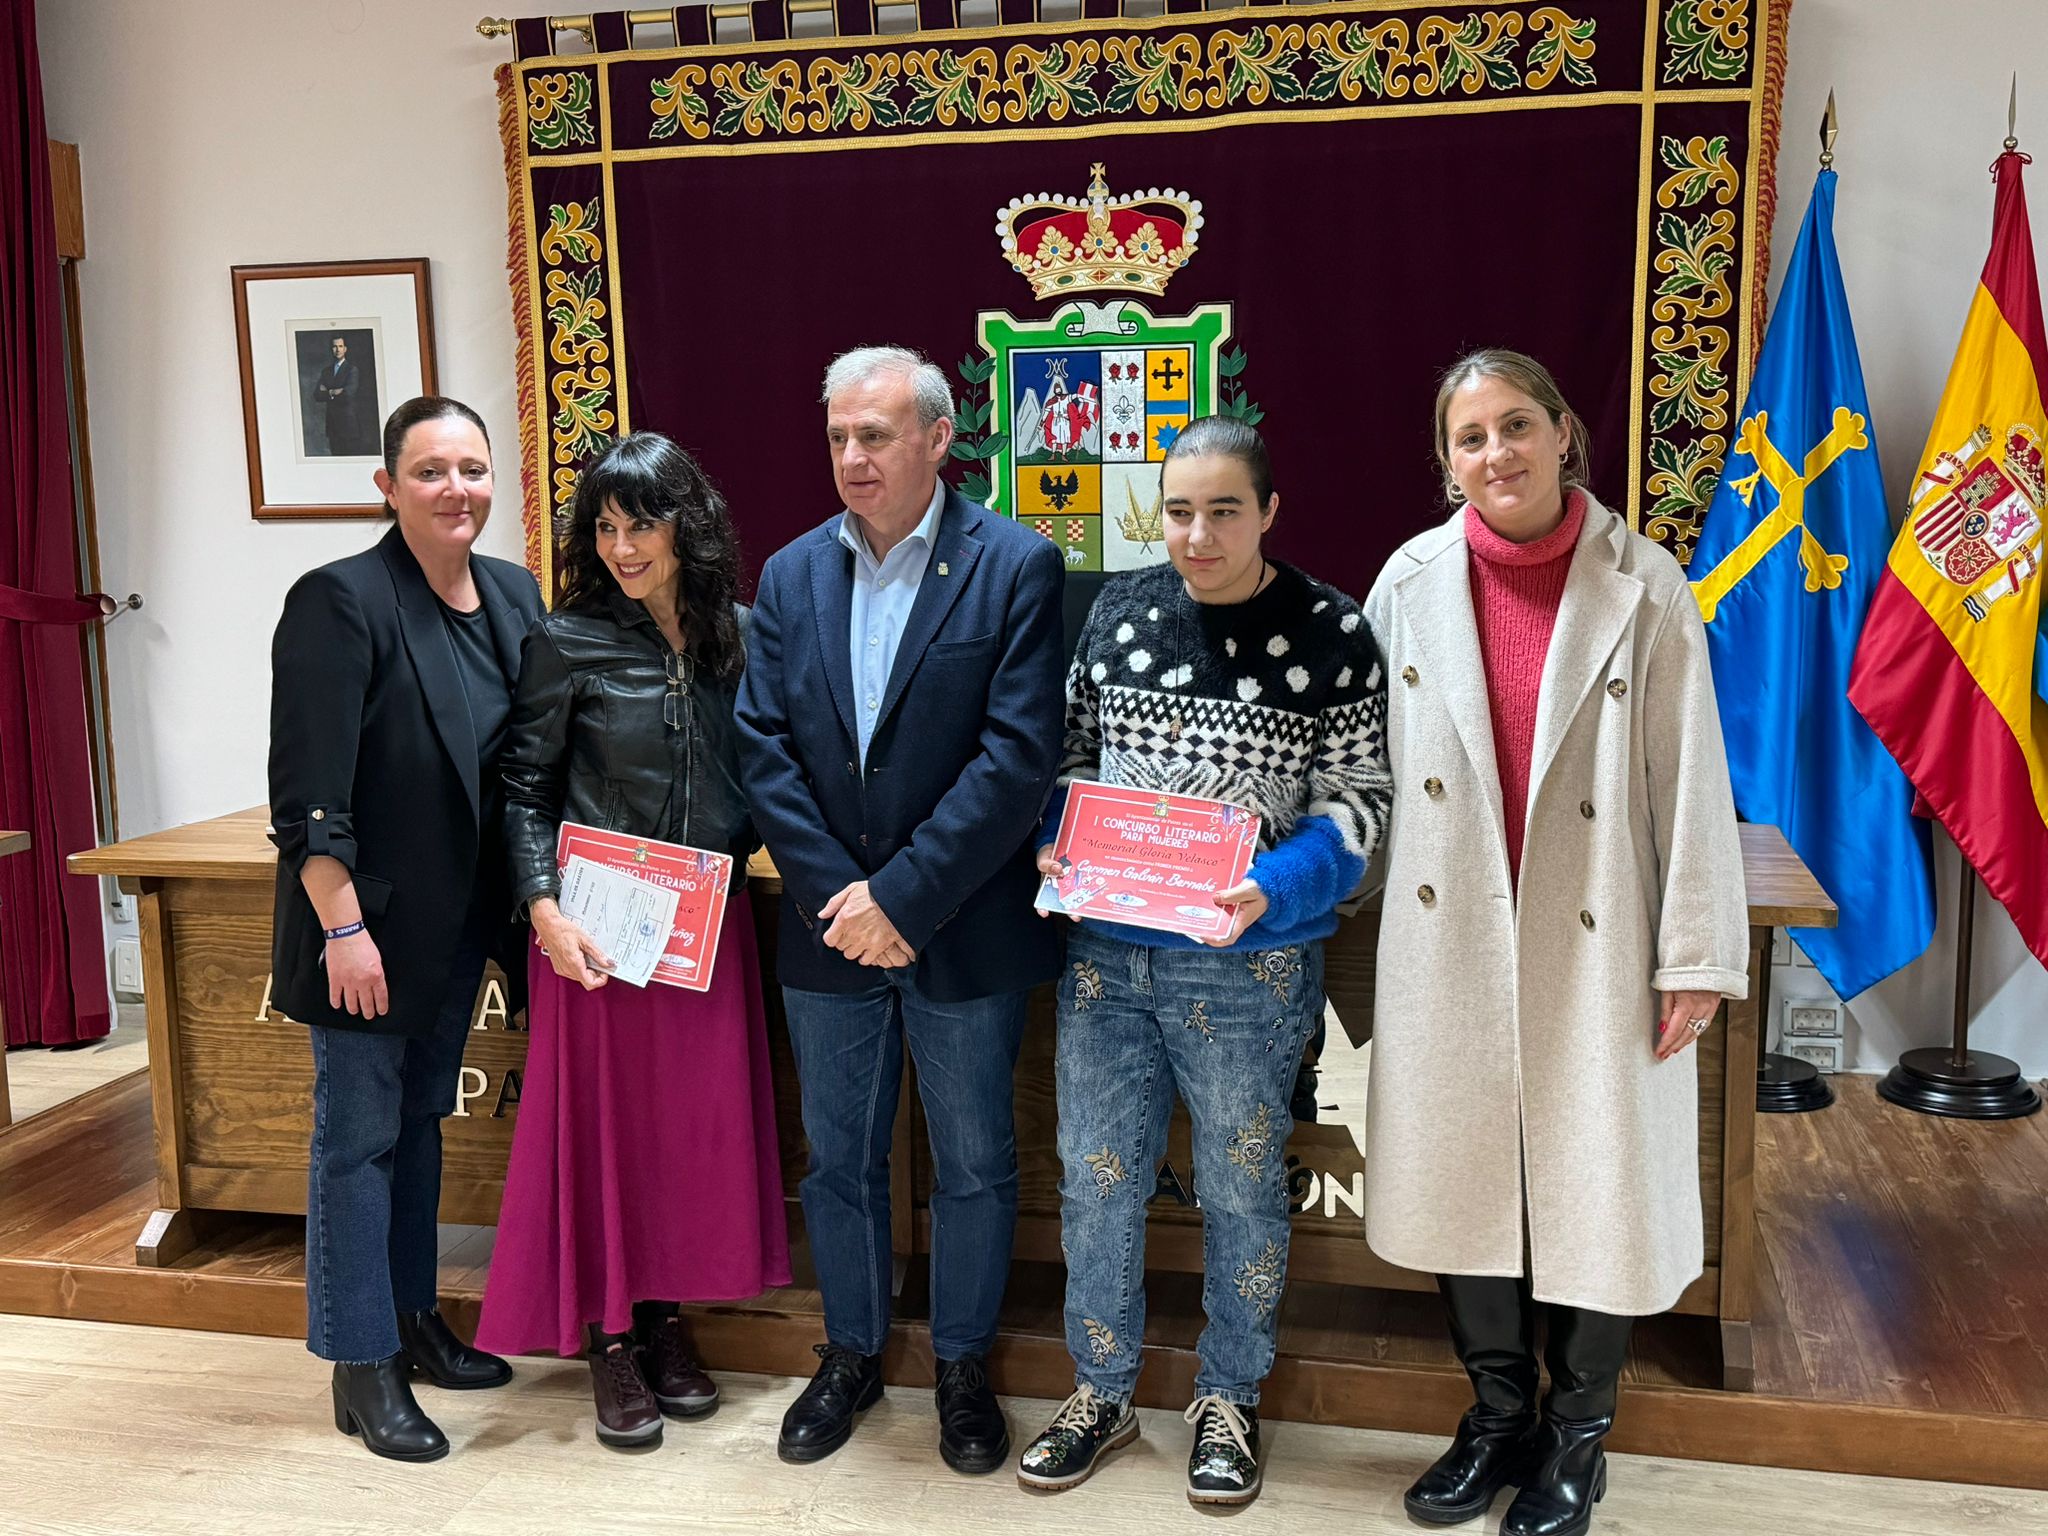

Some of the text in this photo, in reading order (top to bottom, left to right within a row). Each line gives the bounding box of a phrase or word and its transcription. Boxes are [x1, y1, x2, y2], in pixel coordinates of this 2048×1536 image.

[1093, 815, 1221, 844] I CONCURSO LITERARIO
[1120, 831, 1189, 849] PARA MUJERES
[1139, 847, 1172, 860] Gloria
[644, 871, 697, 891] LITERARIO
[1077, 859, 1218, 892] Carmen Galván Bernabé
[671, 924, 696, 947] uñoz
